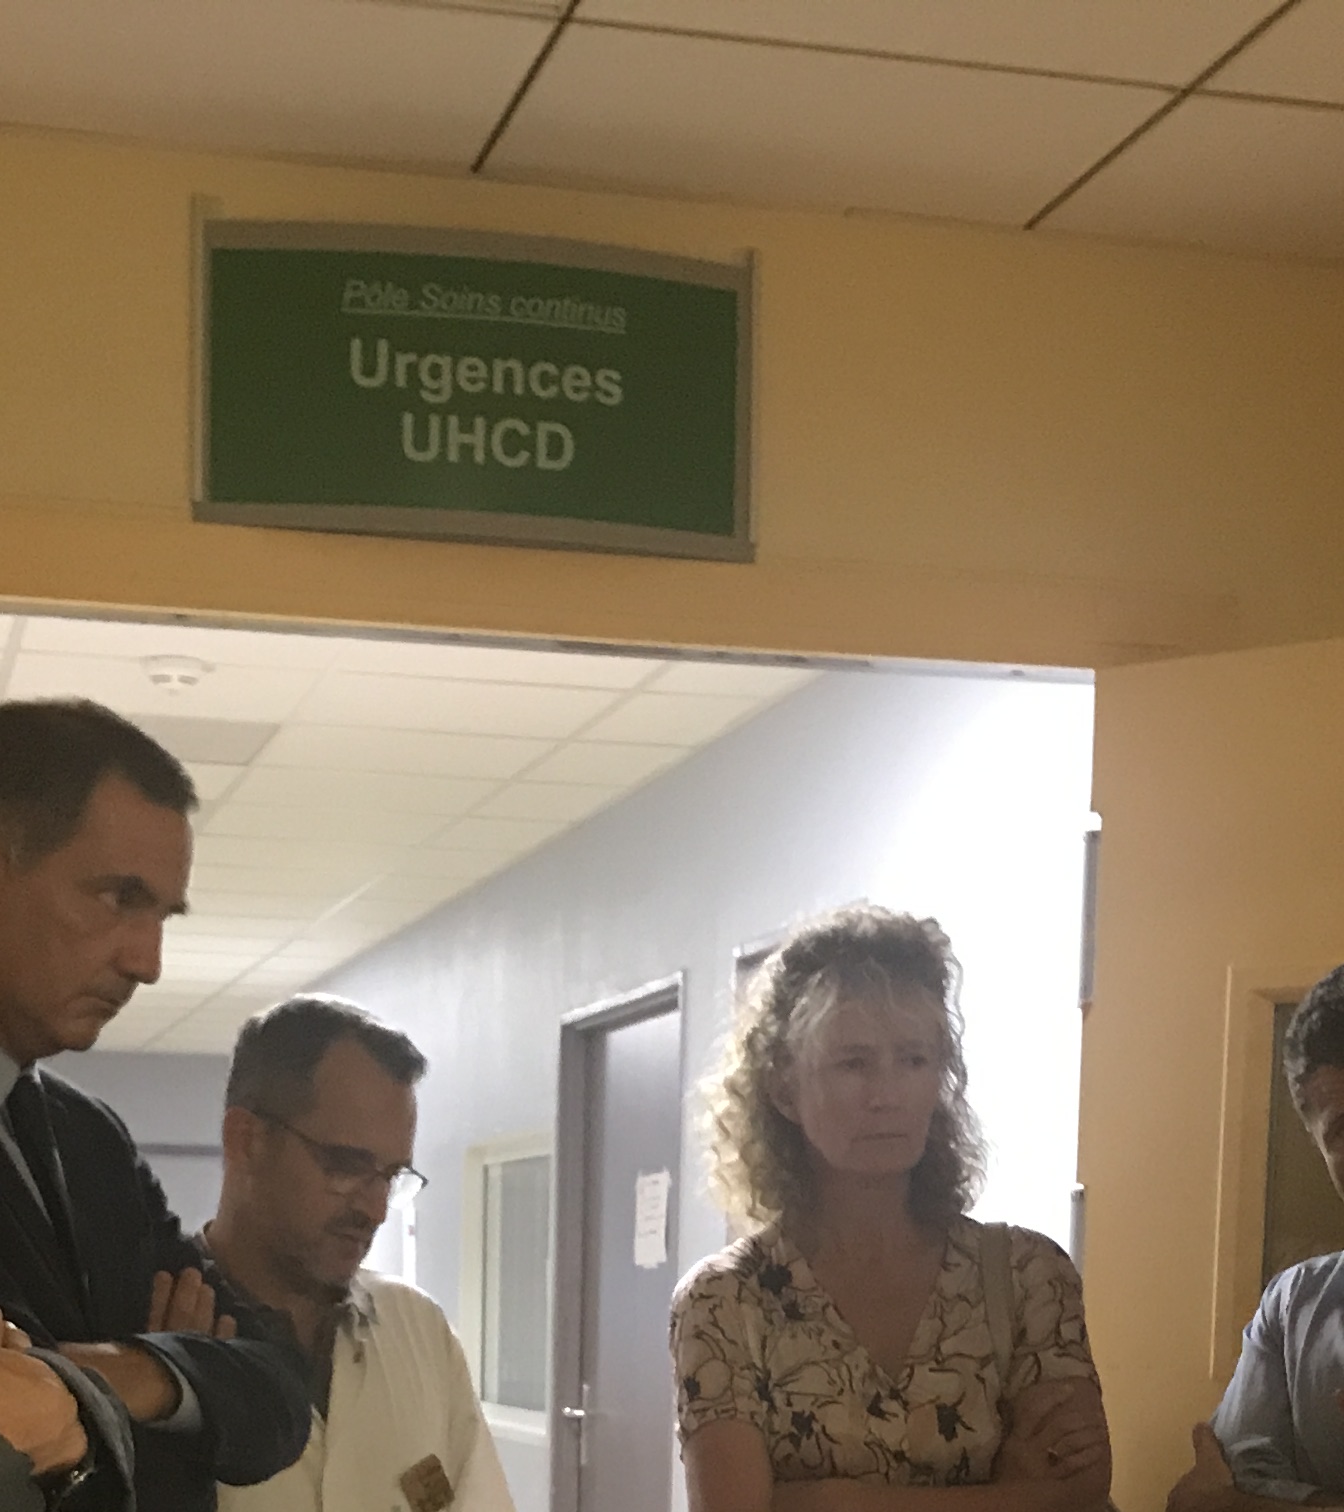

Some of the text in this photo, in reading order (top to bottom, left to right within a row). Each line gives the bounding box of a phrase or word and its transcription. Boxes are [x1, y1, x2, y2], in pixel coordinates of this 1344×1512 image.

[420, 282, 502, 316] Soins
[509, 296, 627, 330] continus
[349, 338, 624, 405] Urgences
[402, 413, 575, 470] UHCD
